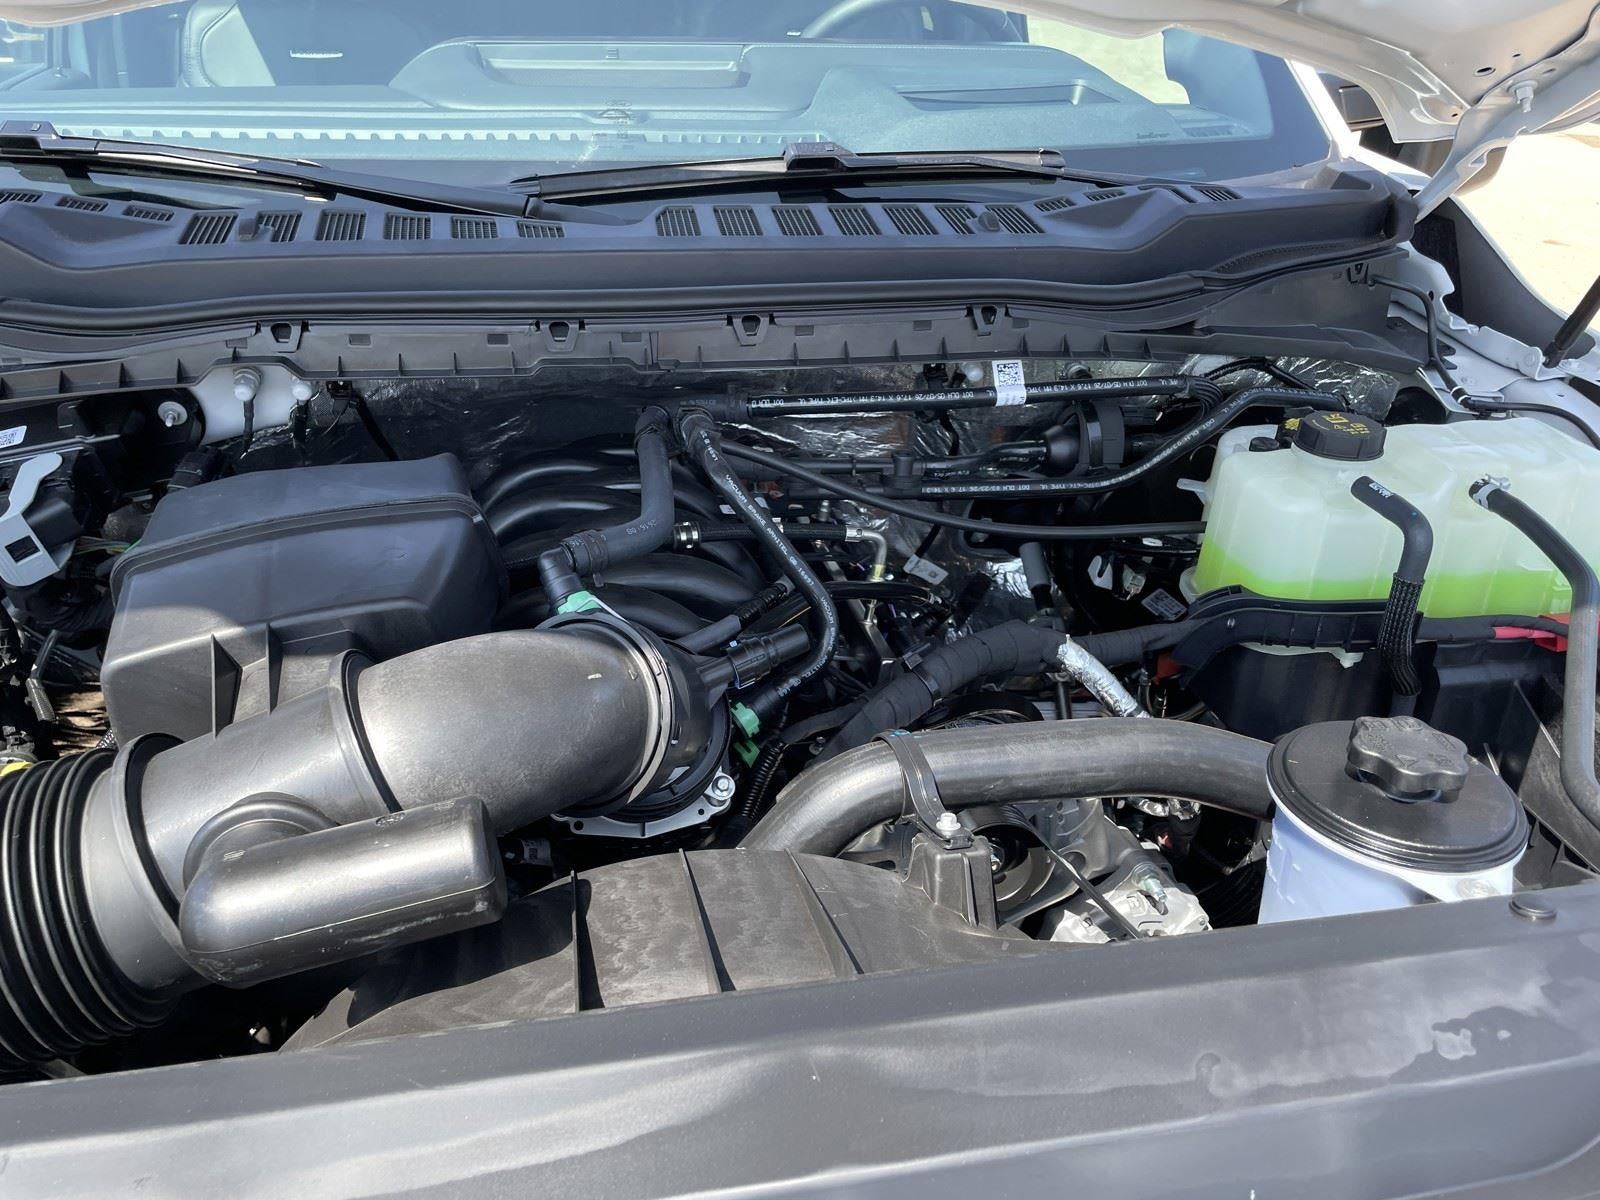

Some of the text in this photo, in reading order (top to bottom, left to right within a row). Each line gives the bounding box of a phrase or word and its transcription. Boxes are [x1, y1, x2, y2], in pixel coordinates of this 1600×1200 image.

[888, 394, 894, 402] X
[962, 391, 974, 399] DOT
[1018, 484, 1030, 492] DOT
[726, 474, 748, 503] VACUUM
[748, 504, 766, 526] BRAKE
[820, 597, 834, 624] VACUUM
[828, 627, 836, 652] BRAKE
